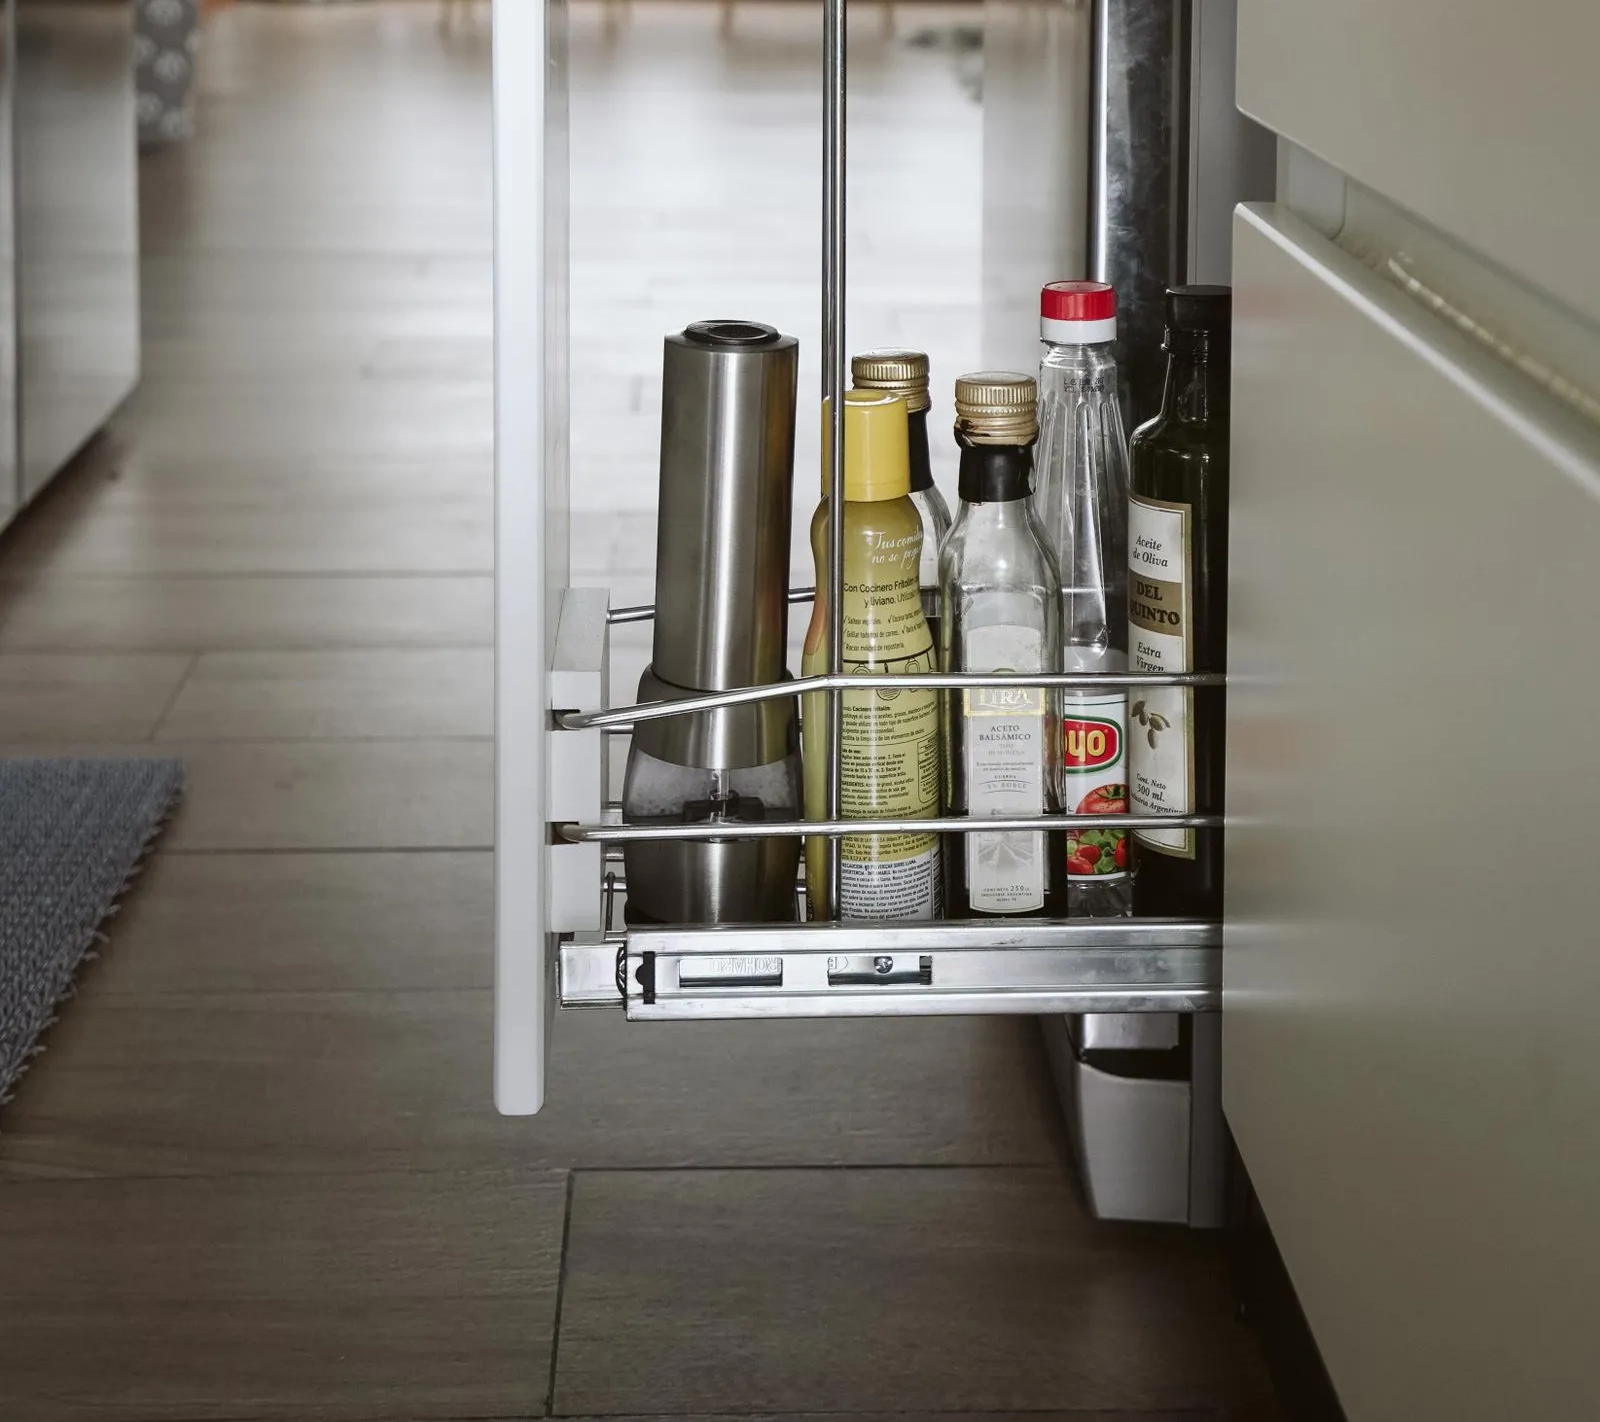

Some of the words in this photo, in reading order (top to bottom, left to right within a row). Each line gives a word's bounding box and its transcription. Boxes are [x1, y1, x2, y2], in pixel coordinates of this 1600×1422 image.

[1136, 535, 1162, 551] Aceite
[1132, 548, 1140, 560] de
[1142, 552, 1168, 567] Oliva
[844, 583, 858, 592] Con
[860, 584, 893, 593] Cocinero
[1136, 581, 1163, 601] DEL
[864, 599, 869, 608] y
[870, 596, 896, 606] liviano.
[1137, 642, 1161, 659] Extra
[1135, 655, 1164, 672] Virgen
[1065, 729, 1105, 763] yo
[1137, 773, 1149, 784] Cont.
[1151, 780, 1166, 790] Neto
[1152, 792, 1165, 802] ml.
